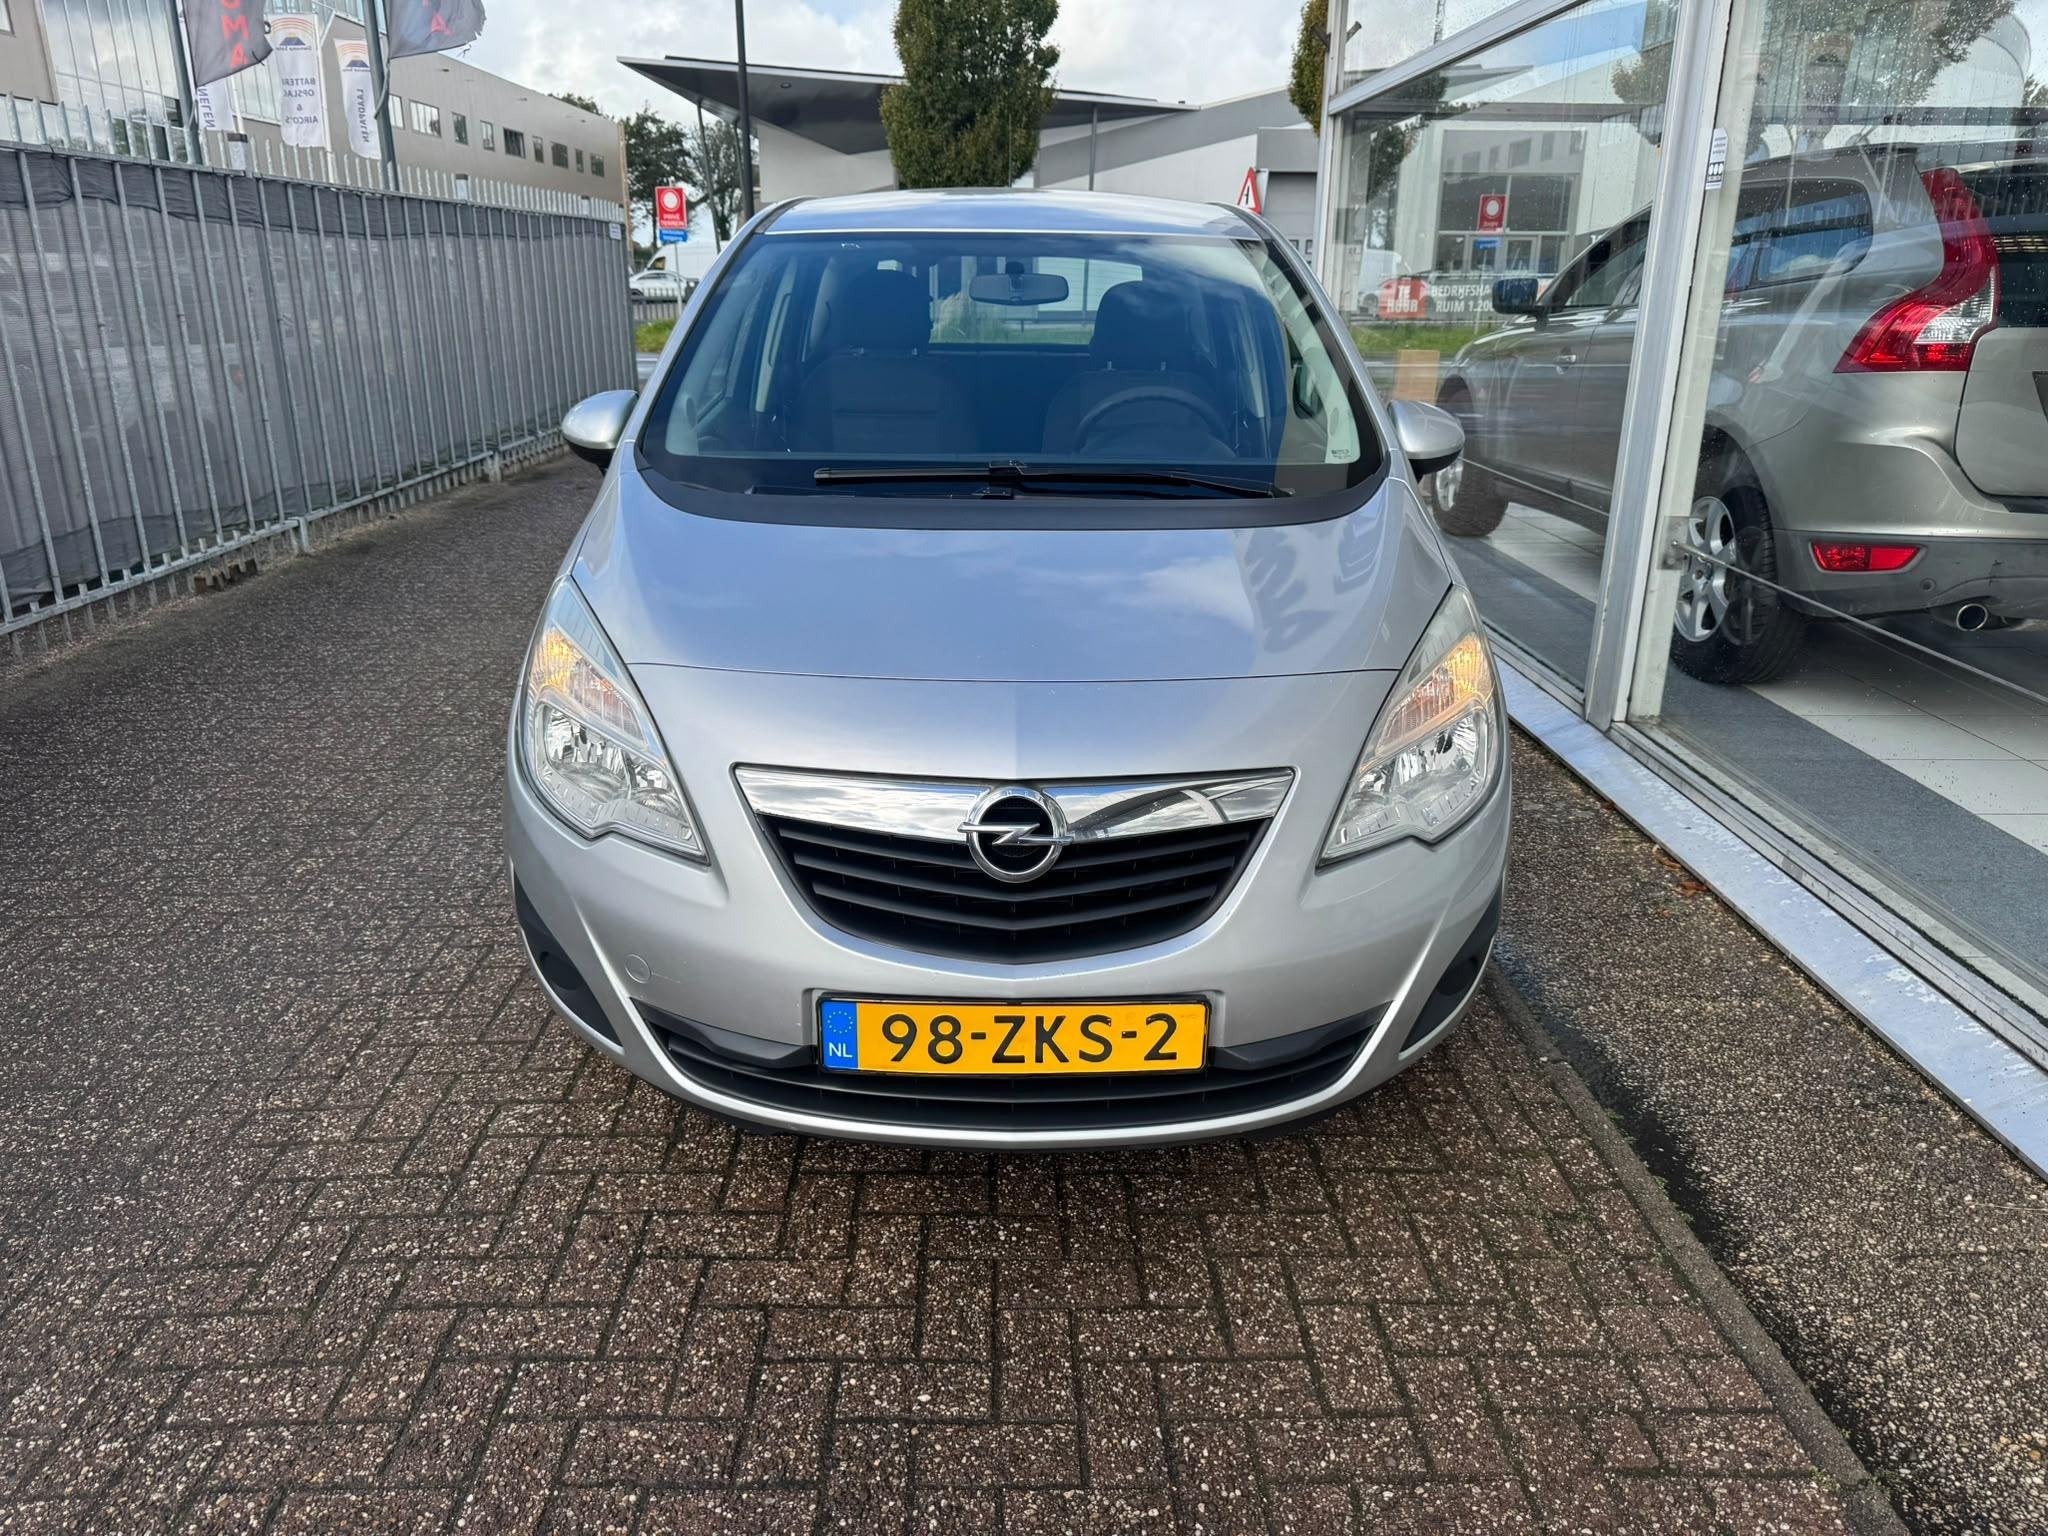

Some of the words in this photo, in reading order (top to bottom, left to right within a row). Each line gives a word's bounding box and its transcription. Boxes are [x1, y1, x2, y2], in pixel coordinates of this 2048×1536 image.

[1436, 301, 1465, 312] RUIM
[881, 1013, 1178, 1064] 98-ZKS-2
[829, 1042, 853, 1058] NL
